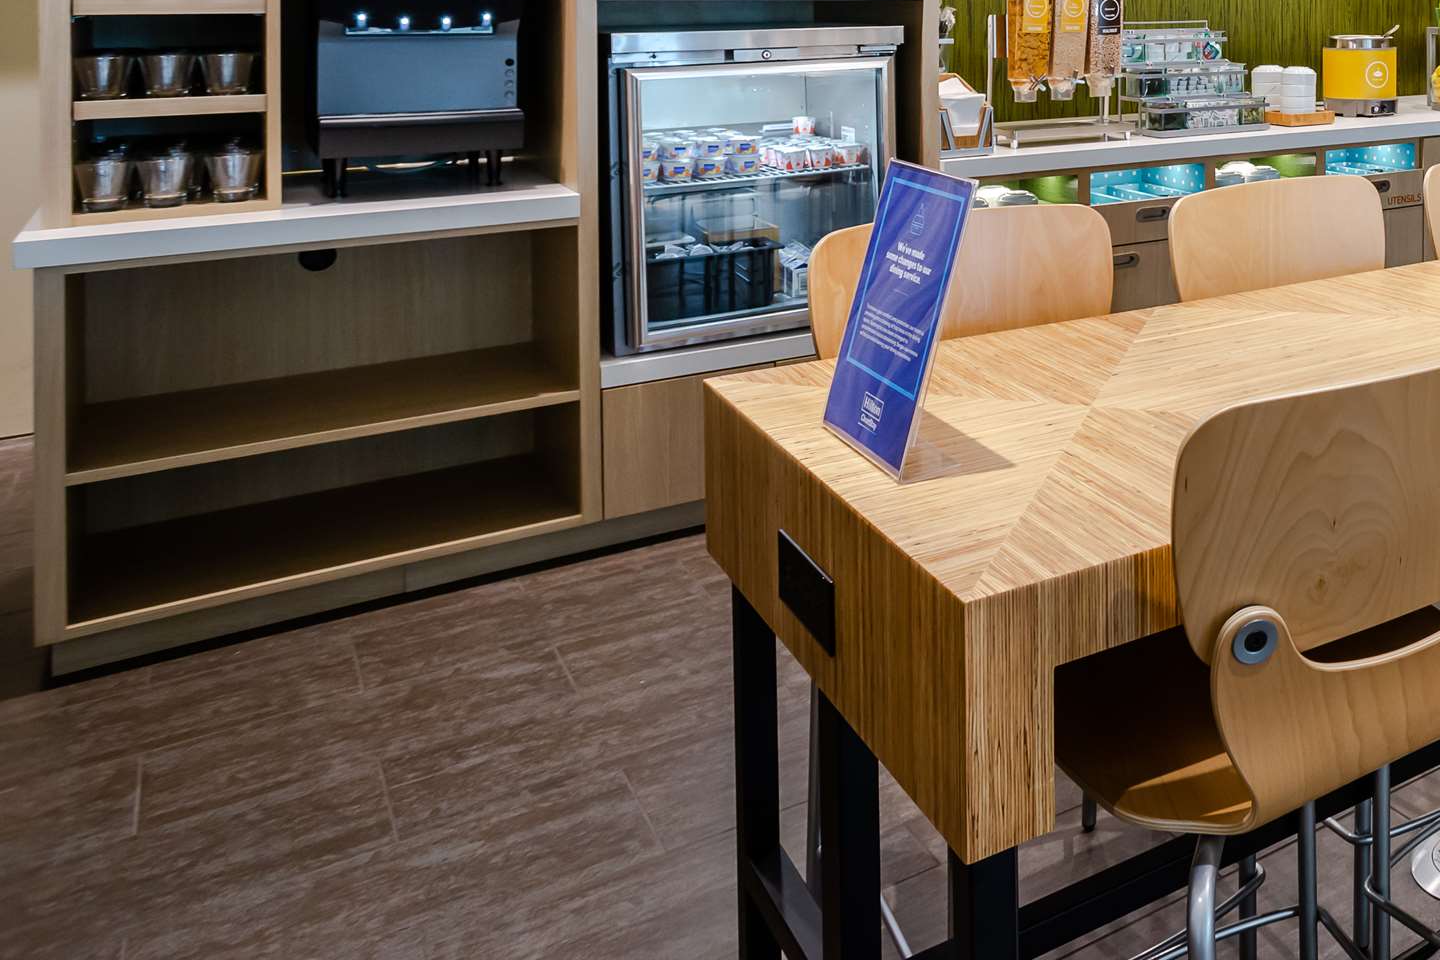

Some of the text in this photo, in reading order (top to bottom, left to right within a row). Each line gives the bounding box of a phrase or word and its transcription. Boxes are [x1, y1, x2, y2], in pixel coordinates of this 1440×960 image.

[1387, 192, 1422, 206] UTENSILS
[911, 248, 926, 260] made
[889, 263, 904, 279] dining
[898, 255, 917, 271] changes
[916, 262, 923, 272] to
[922, 266, 932, 276] our
[863, 395, 881, 417] Hilton
